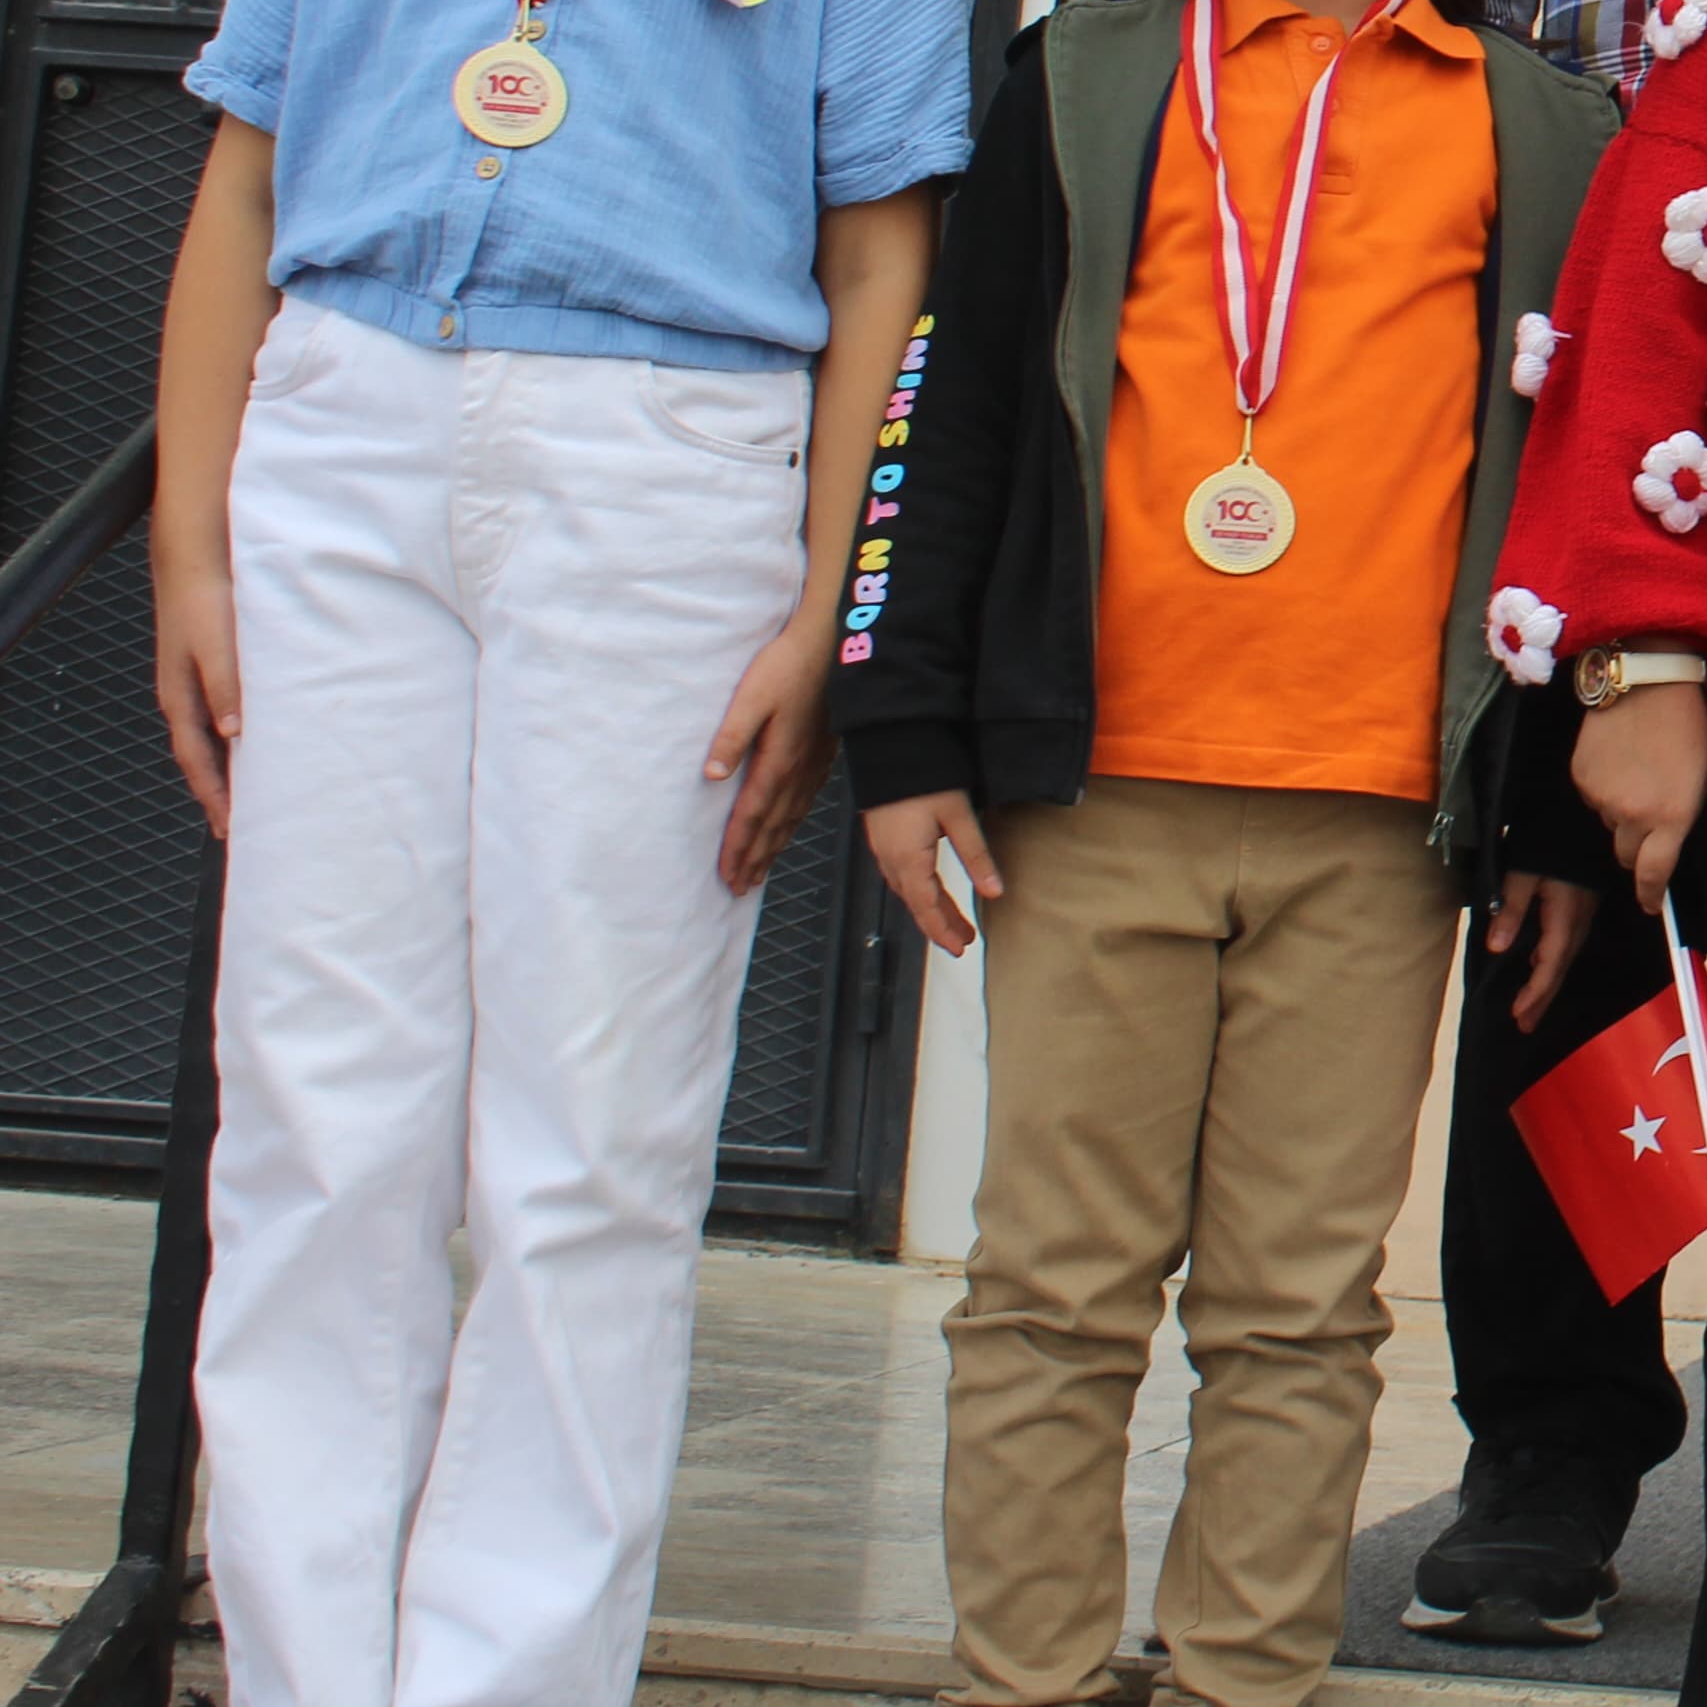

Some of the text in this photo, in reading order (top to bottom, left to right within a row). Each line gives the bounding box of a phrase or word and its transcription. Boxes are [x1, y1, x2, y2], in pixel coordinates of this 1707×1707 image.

[839, 313, 935, 664] BORN TO SHINE
